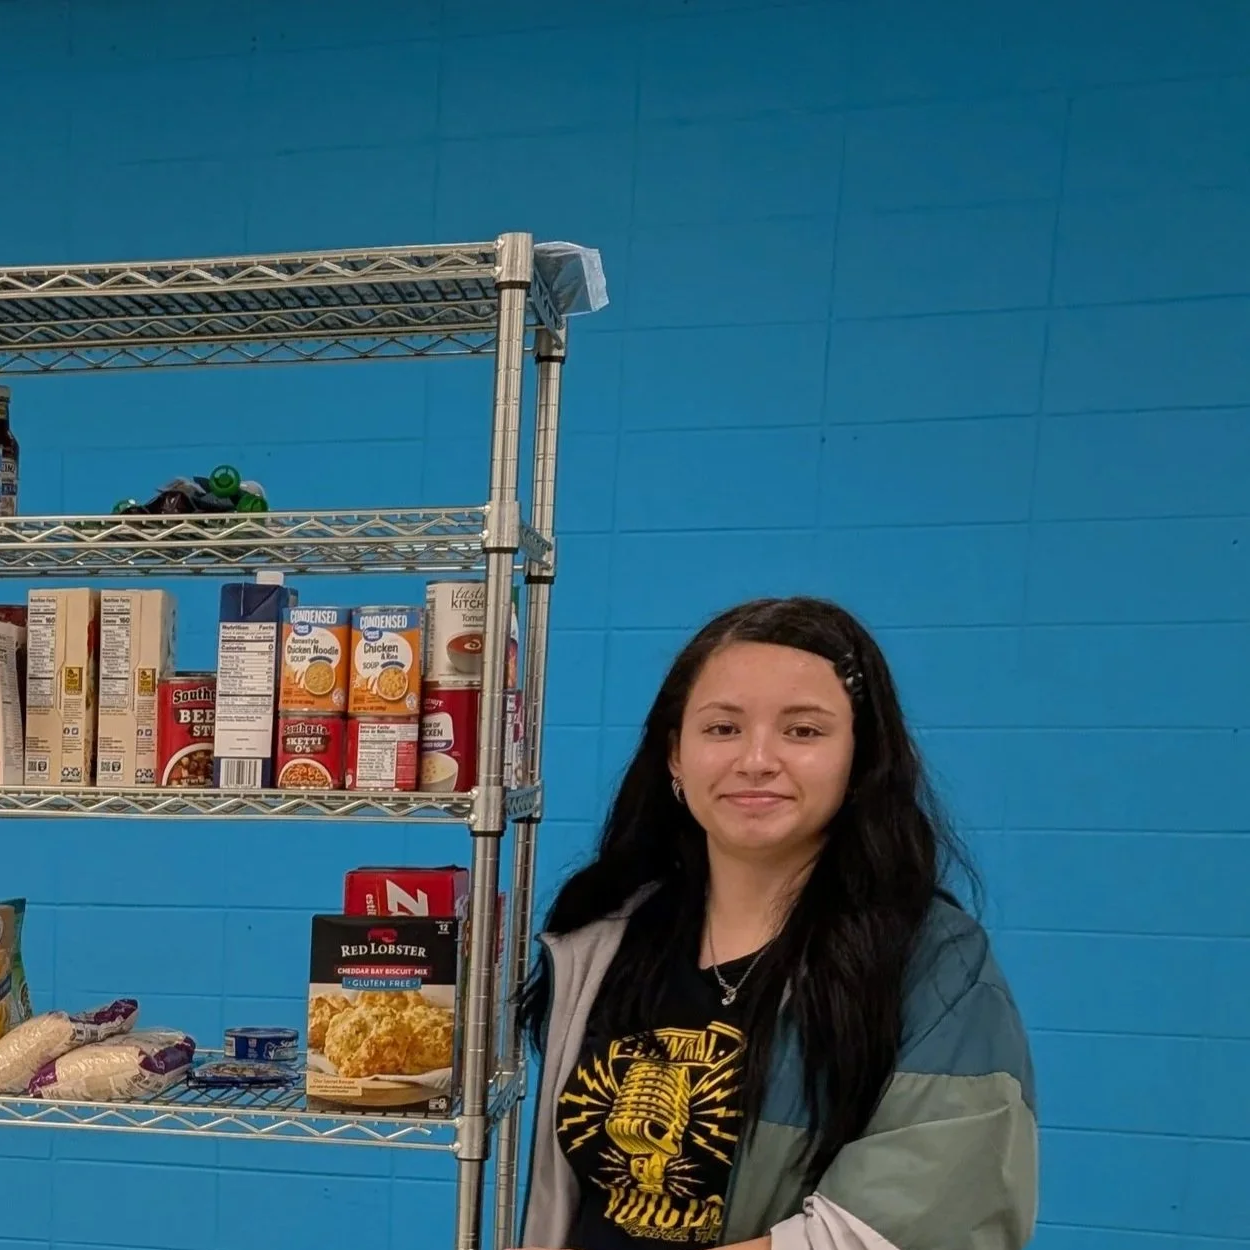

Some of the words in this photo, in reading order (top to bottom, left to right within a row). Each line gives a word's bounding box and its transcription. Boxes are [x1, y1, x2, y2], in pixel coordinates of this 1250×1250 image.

[451, 599, 485, 609] KITCH
[290, 610, 338, 624] CONDENSED
[360, 615, 408, 629] CONDENSED
[461, 613, 485, 622] Tomat
[286, 646, 312, 654] Chicken
[312, 645, 339, 656] Noodle
[363, 642, 399, 653] Chicken
[179, 709, 215, 724] BEE
[286, 737, 322, 745] SKETTI
[439, 924, 449, 932] 12
[341, 943, 369, 958] RED
[370, 942, 427, 958] LOBSTER
[337, 967, 369, 975] CHEDDAR
[370, 967, 383, 975] BAY
[385, 967, 411, 975] BISCUIT
[352, 979, 386, 987] GLUTEN
[389, 979, 411, 987] FREE
